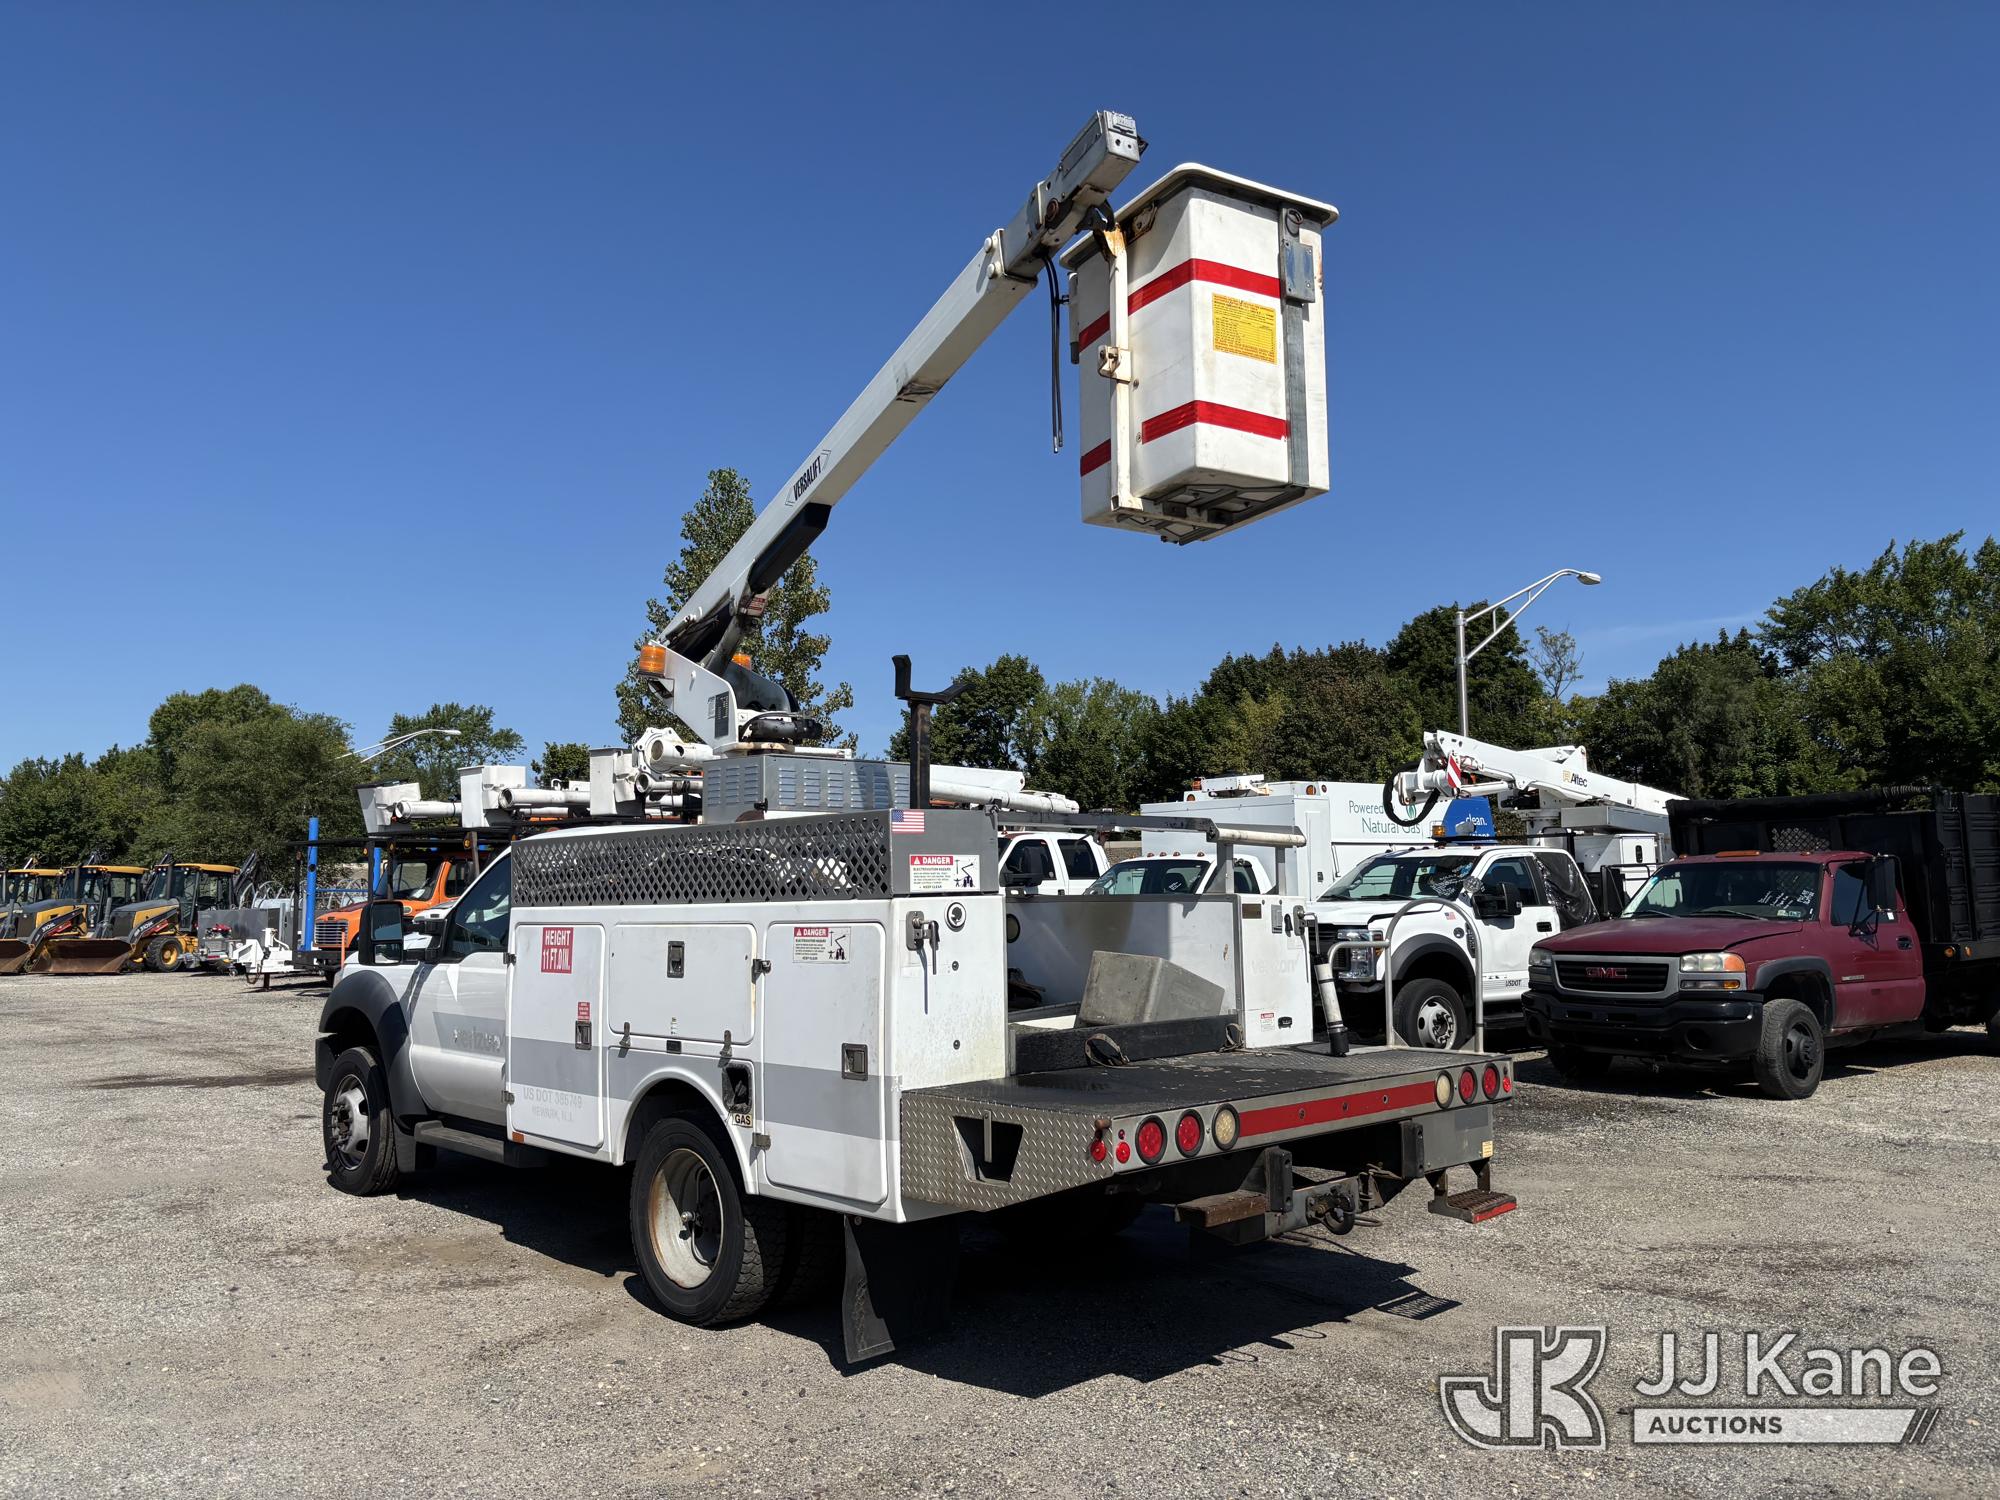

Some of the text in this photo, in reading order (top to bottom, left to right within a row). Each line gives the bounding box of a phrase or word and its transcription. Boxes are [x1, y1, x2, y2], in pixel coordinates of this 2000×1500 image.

[792, 455, 822, 501] VERSALIFT
[1571, 773, 1588, 788] Altec
[1348, 801, 1384, 815] Powered
[1362, 817, 1399, 834] Natural
[922, 856, 951, 865] DANGER
[545, 930, 571, 946] HEIGHT
[803, 928, 827, 936] DANGER
[1585, 966, 1628, 979] GMC
[523, 1087, 535, 1101] US
[535, 1088, 553, 1104] DOT
[734, 1114, 751, 1125] GAS
